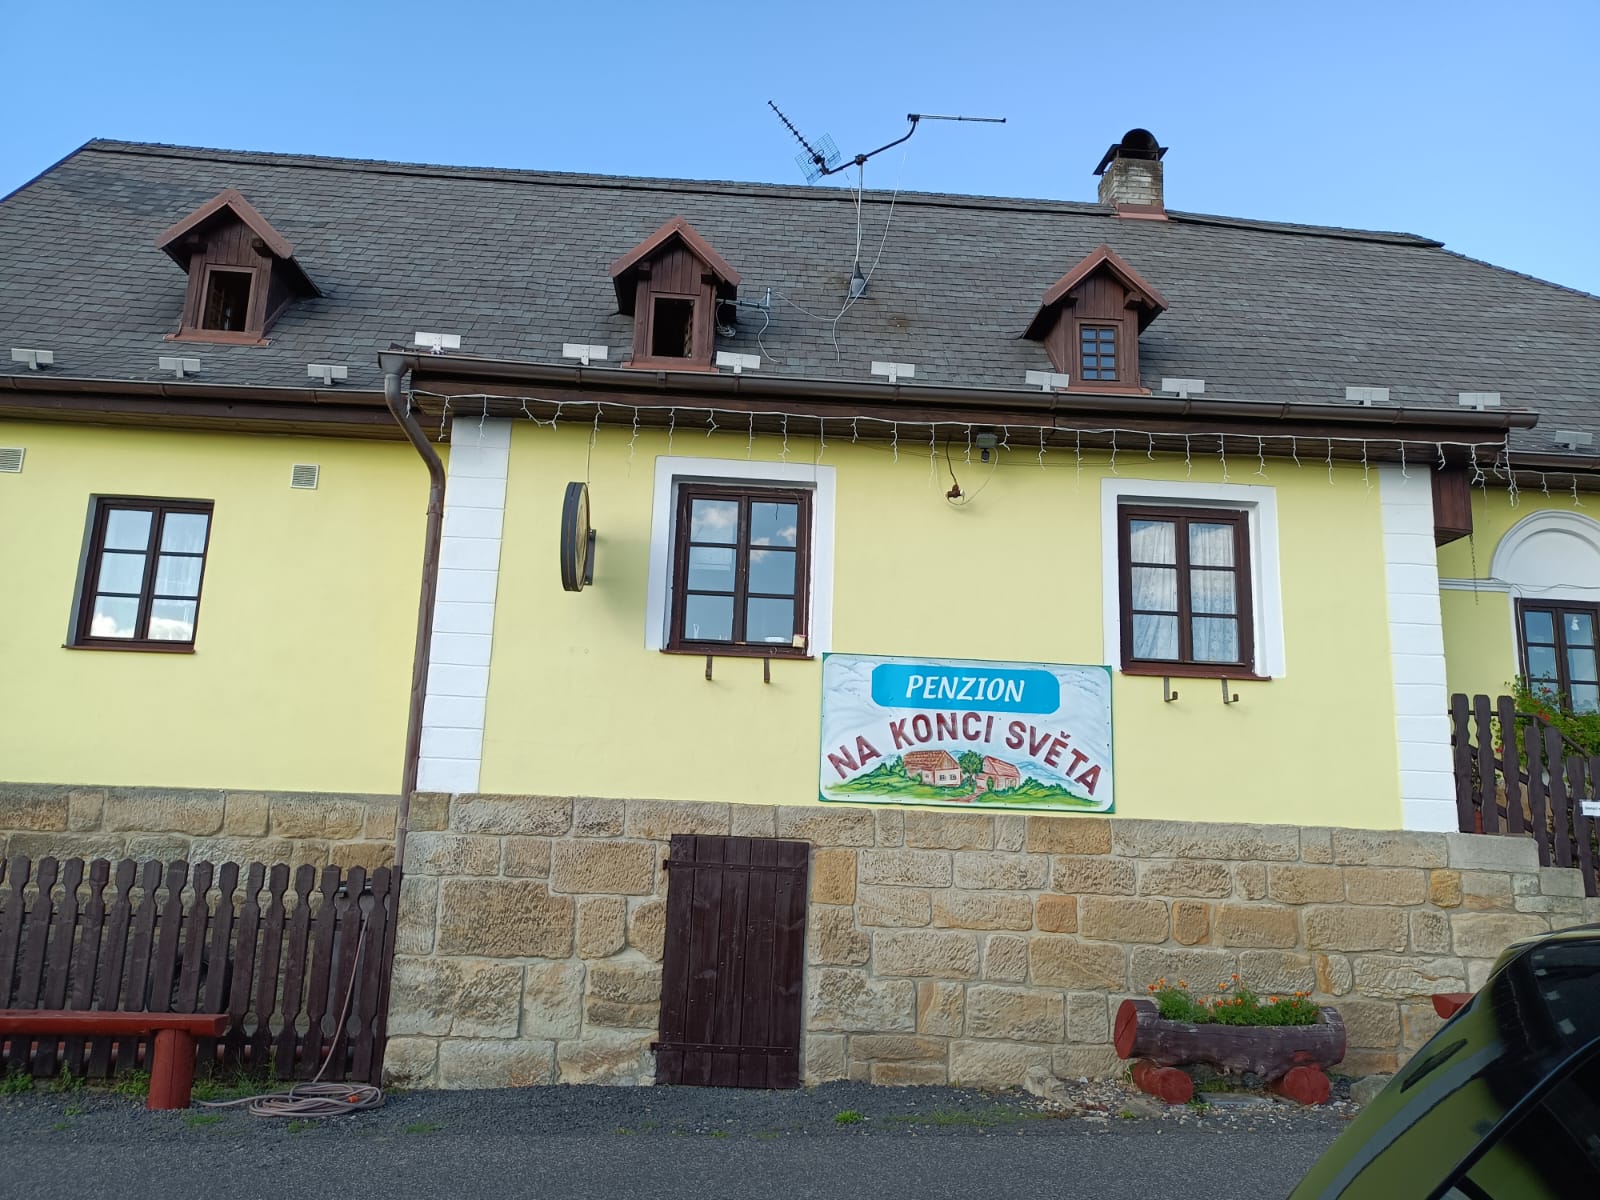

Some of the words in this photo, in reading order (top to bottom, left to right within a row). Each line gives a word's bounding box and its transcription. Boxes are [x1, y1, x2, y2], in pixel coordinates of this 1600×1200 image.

[906, 675, 1025, 702] PENZION
[827, 735, 882, 779] NA
[889, 712, 994, 750] KONCI
[1005, 720, 1102, 796] SVĚTA
